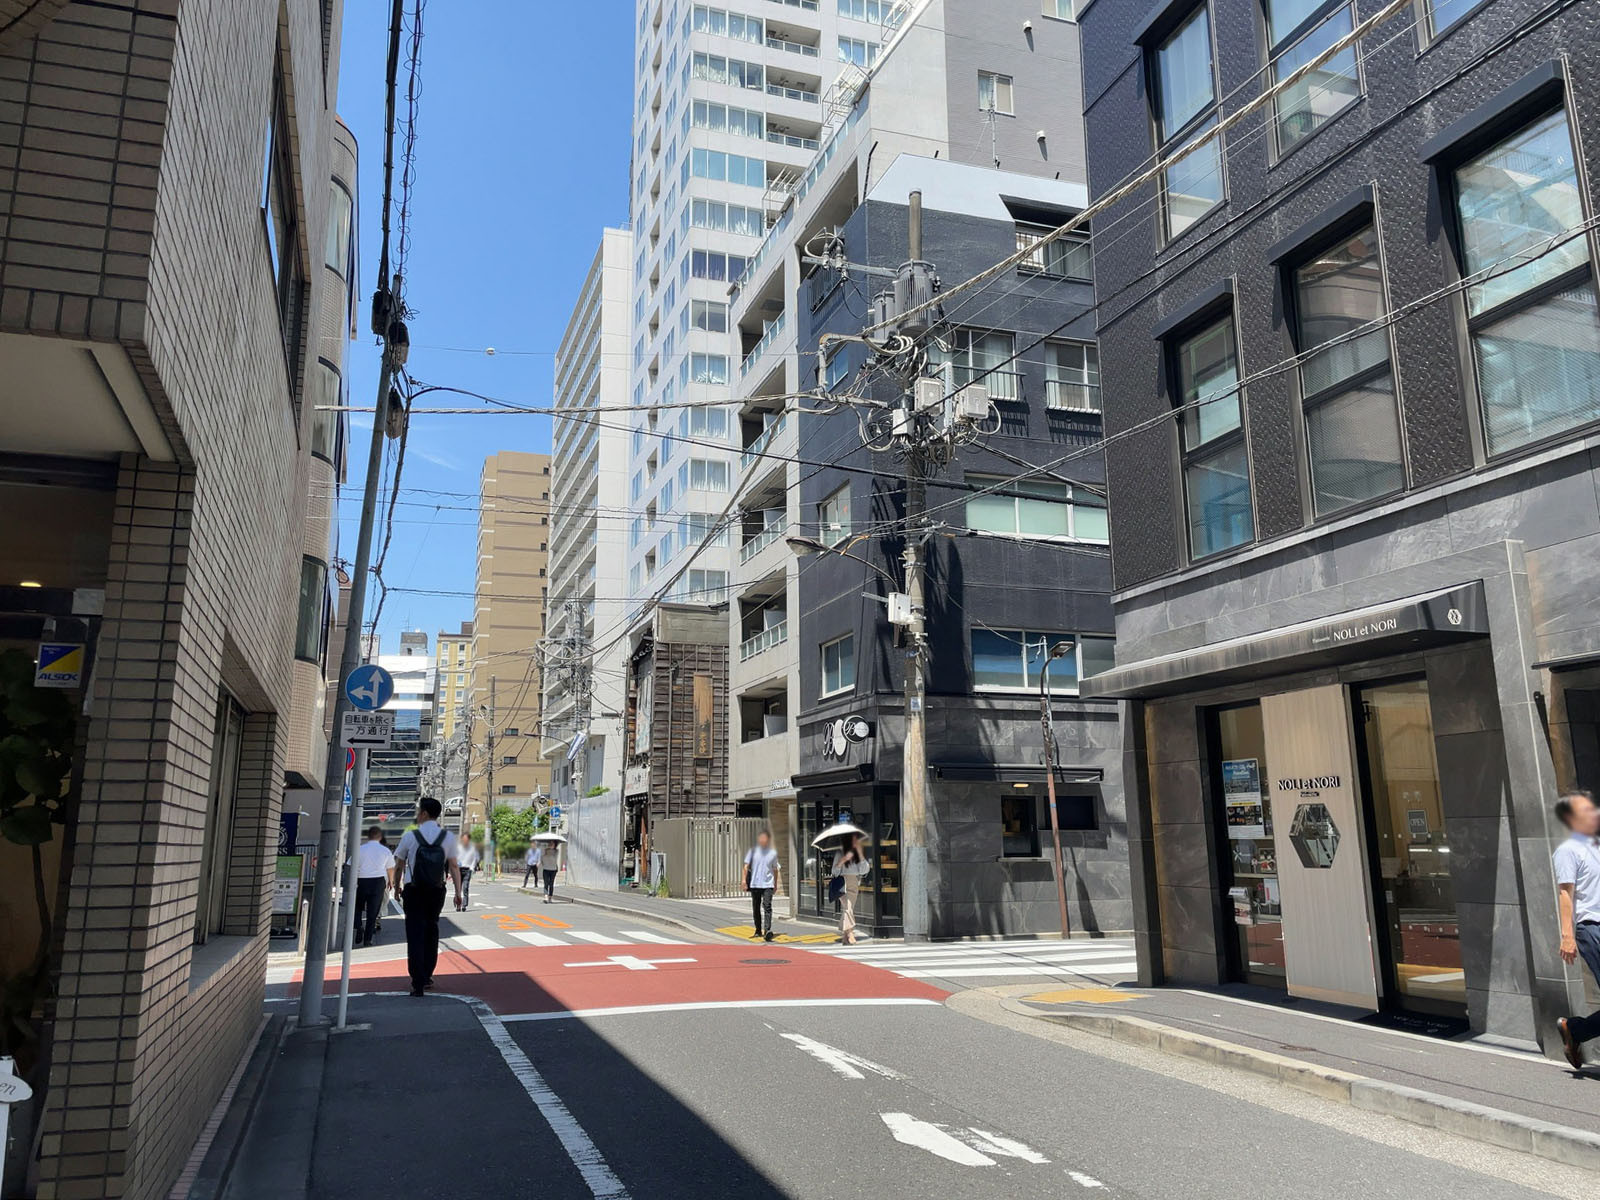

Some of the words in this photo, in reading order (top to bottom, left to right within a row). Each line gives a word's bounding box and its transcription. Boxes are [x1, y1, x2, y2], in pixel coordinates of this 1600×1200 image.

[1333, 627, 1358, 641] NOLI
[1360, 626, 1369, 636] et
[1371, 618, 1397, 633] NORI
[345, 715, 389, 725] 自転車を除く
[344, 726, 388, 736] 一方通行
[1278, 779, 1303, 790] NOLI
[1303, 779, 1313, 789] et
[1313, 776, 1340, 788] NORI
